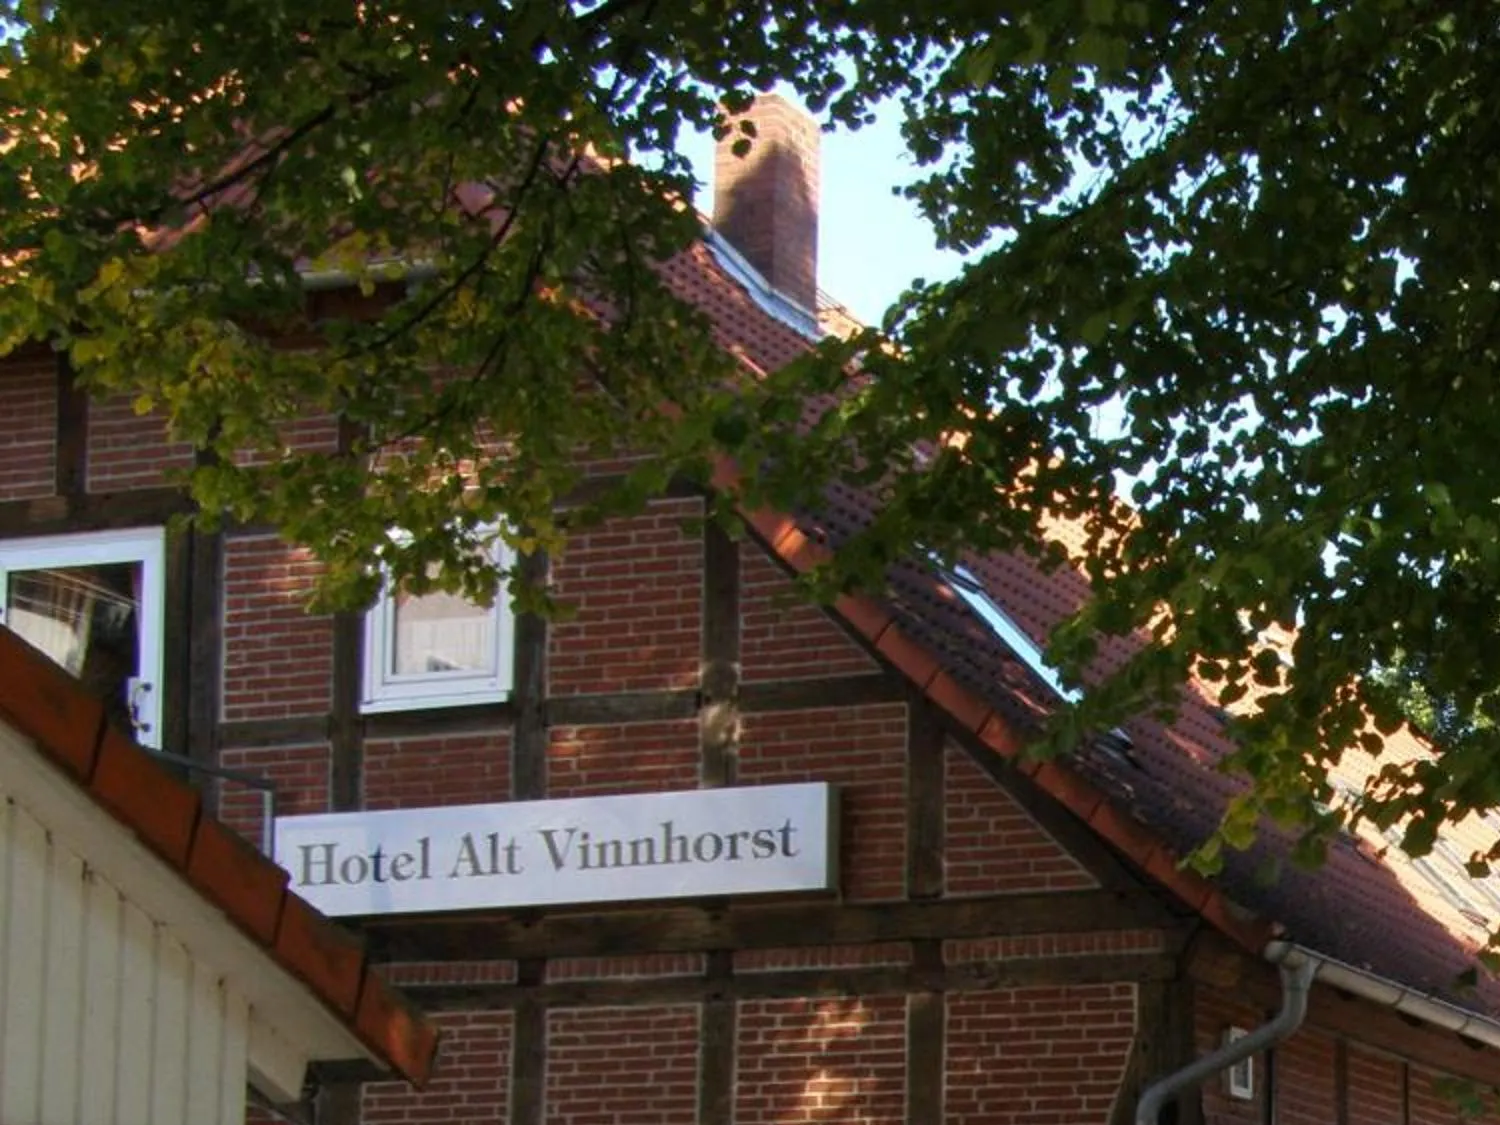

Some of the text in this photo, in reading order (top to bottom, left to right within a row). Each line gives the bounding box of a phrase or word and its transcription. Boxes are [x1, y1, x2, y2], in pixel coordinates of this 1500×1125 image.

[297, 819, 800, 887] Hotel Alt Vinnhorst
